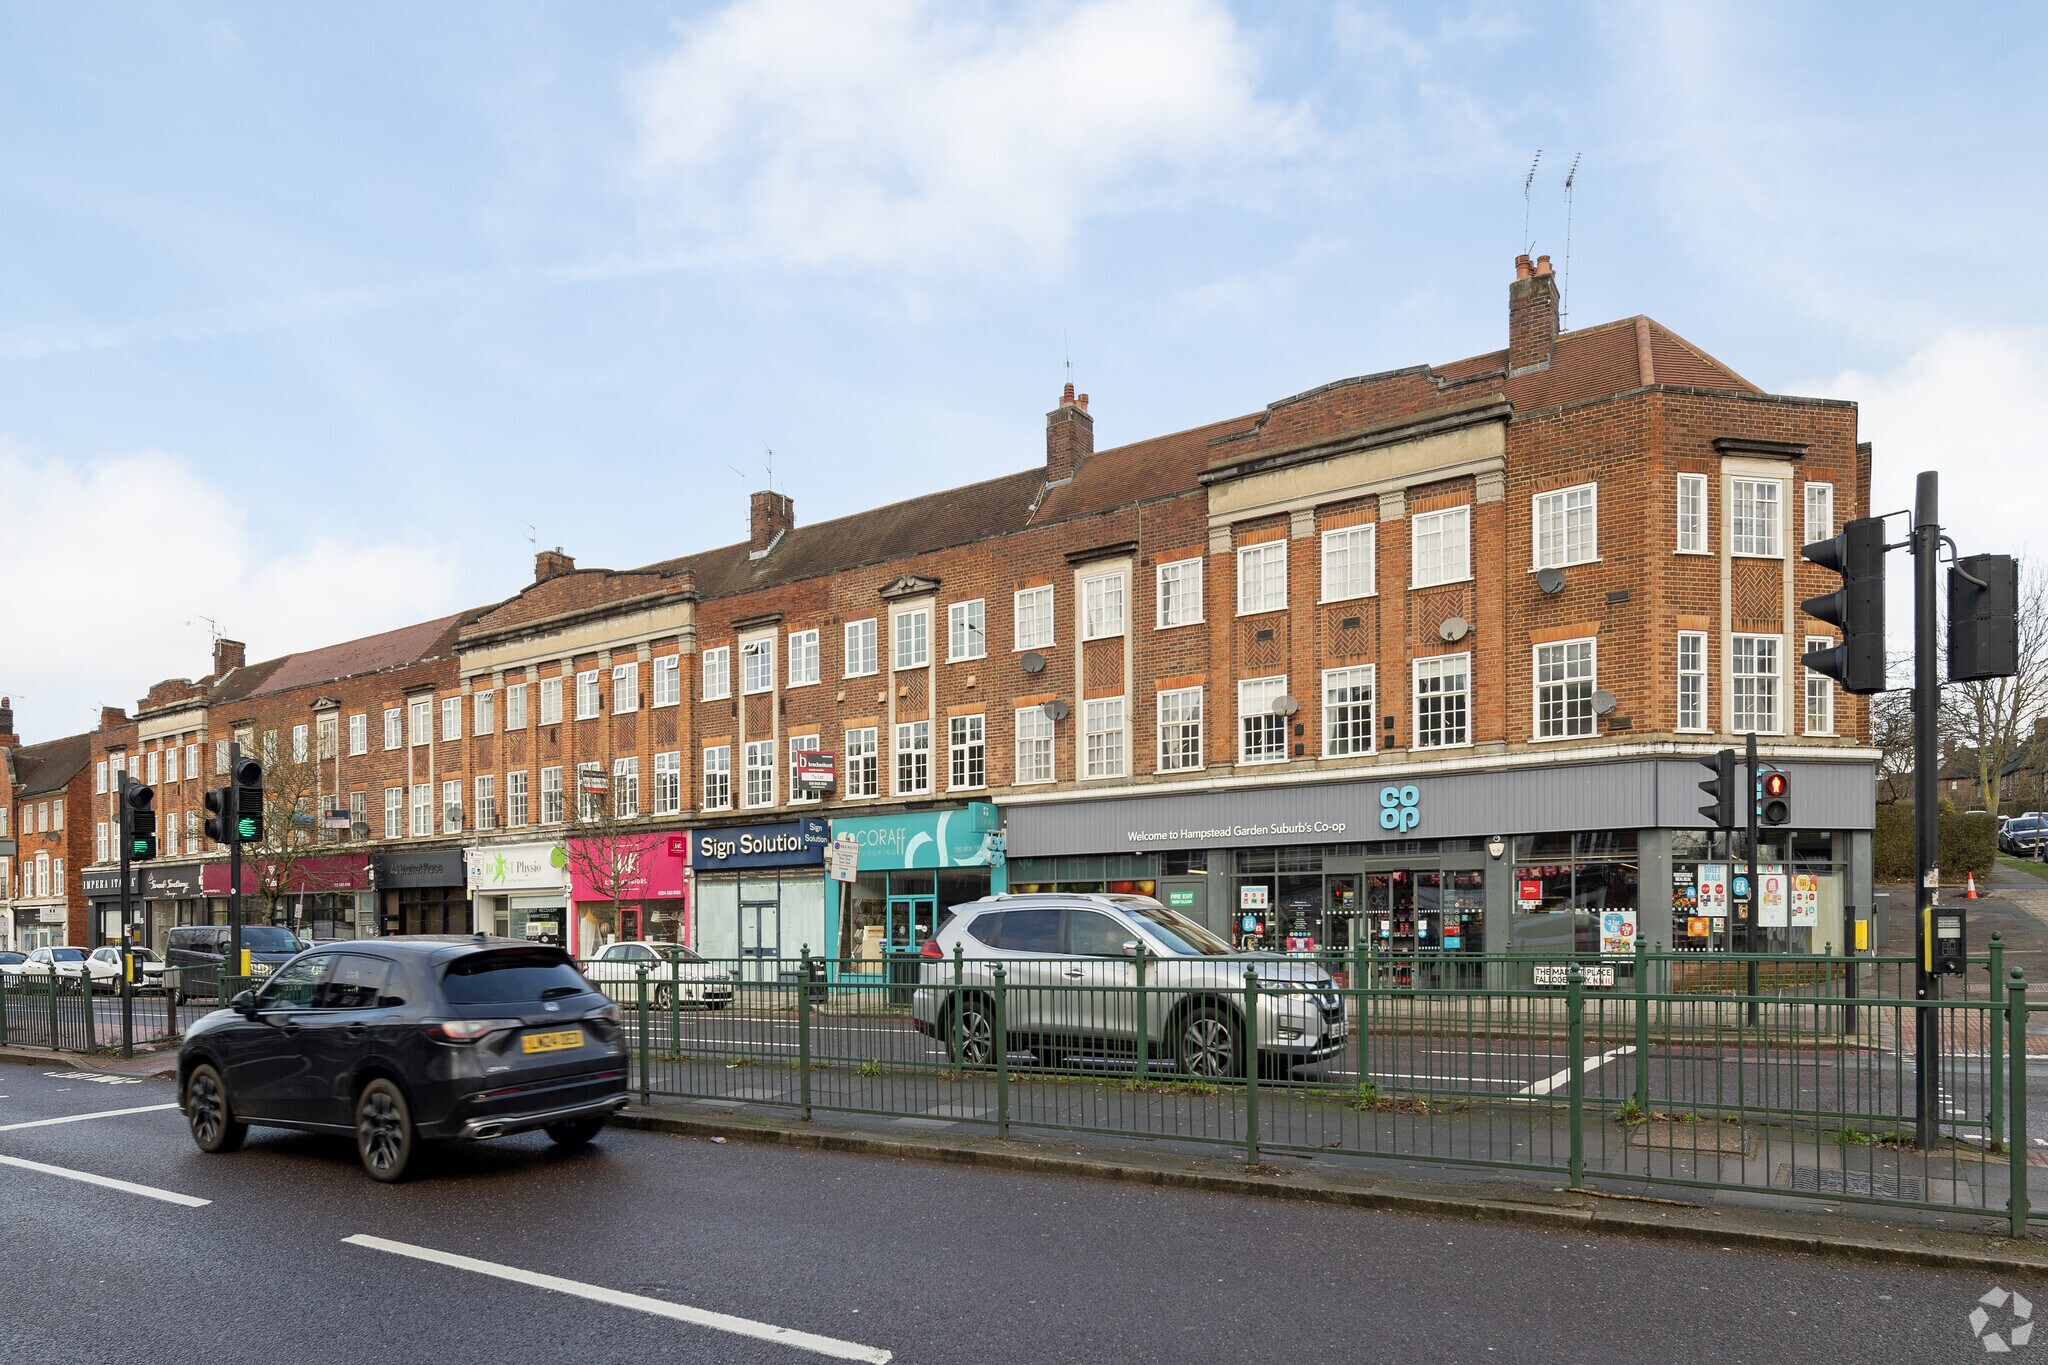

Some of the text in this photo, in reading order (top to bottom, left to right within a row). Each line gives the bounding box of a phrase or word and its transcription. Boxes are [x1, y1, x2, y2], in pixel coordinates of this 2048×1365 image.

[809, 822, 823, 832] Sign
[1127, 820, 1346, 842] Welcome to Hampstead Garden Suburb's Co-op
[804, 834, 828, 844] Solution
[701, 837, 736, 860] Sign
[400, 863, 424, 875] Market
[424, 862, 443, 875] Place
[516, 860, 542, 878] Physio
[1703, 865, 1722, 874] SWEET
[83, 880, 109, 890] IMPERA
[1536, 967, 1550, 976] THE
[1586, 968, 1611, 977] PLACE
[1535, 976, 1570, 985] FALLODE
